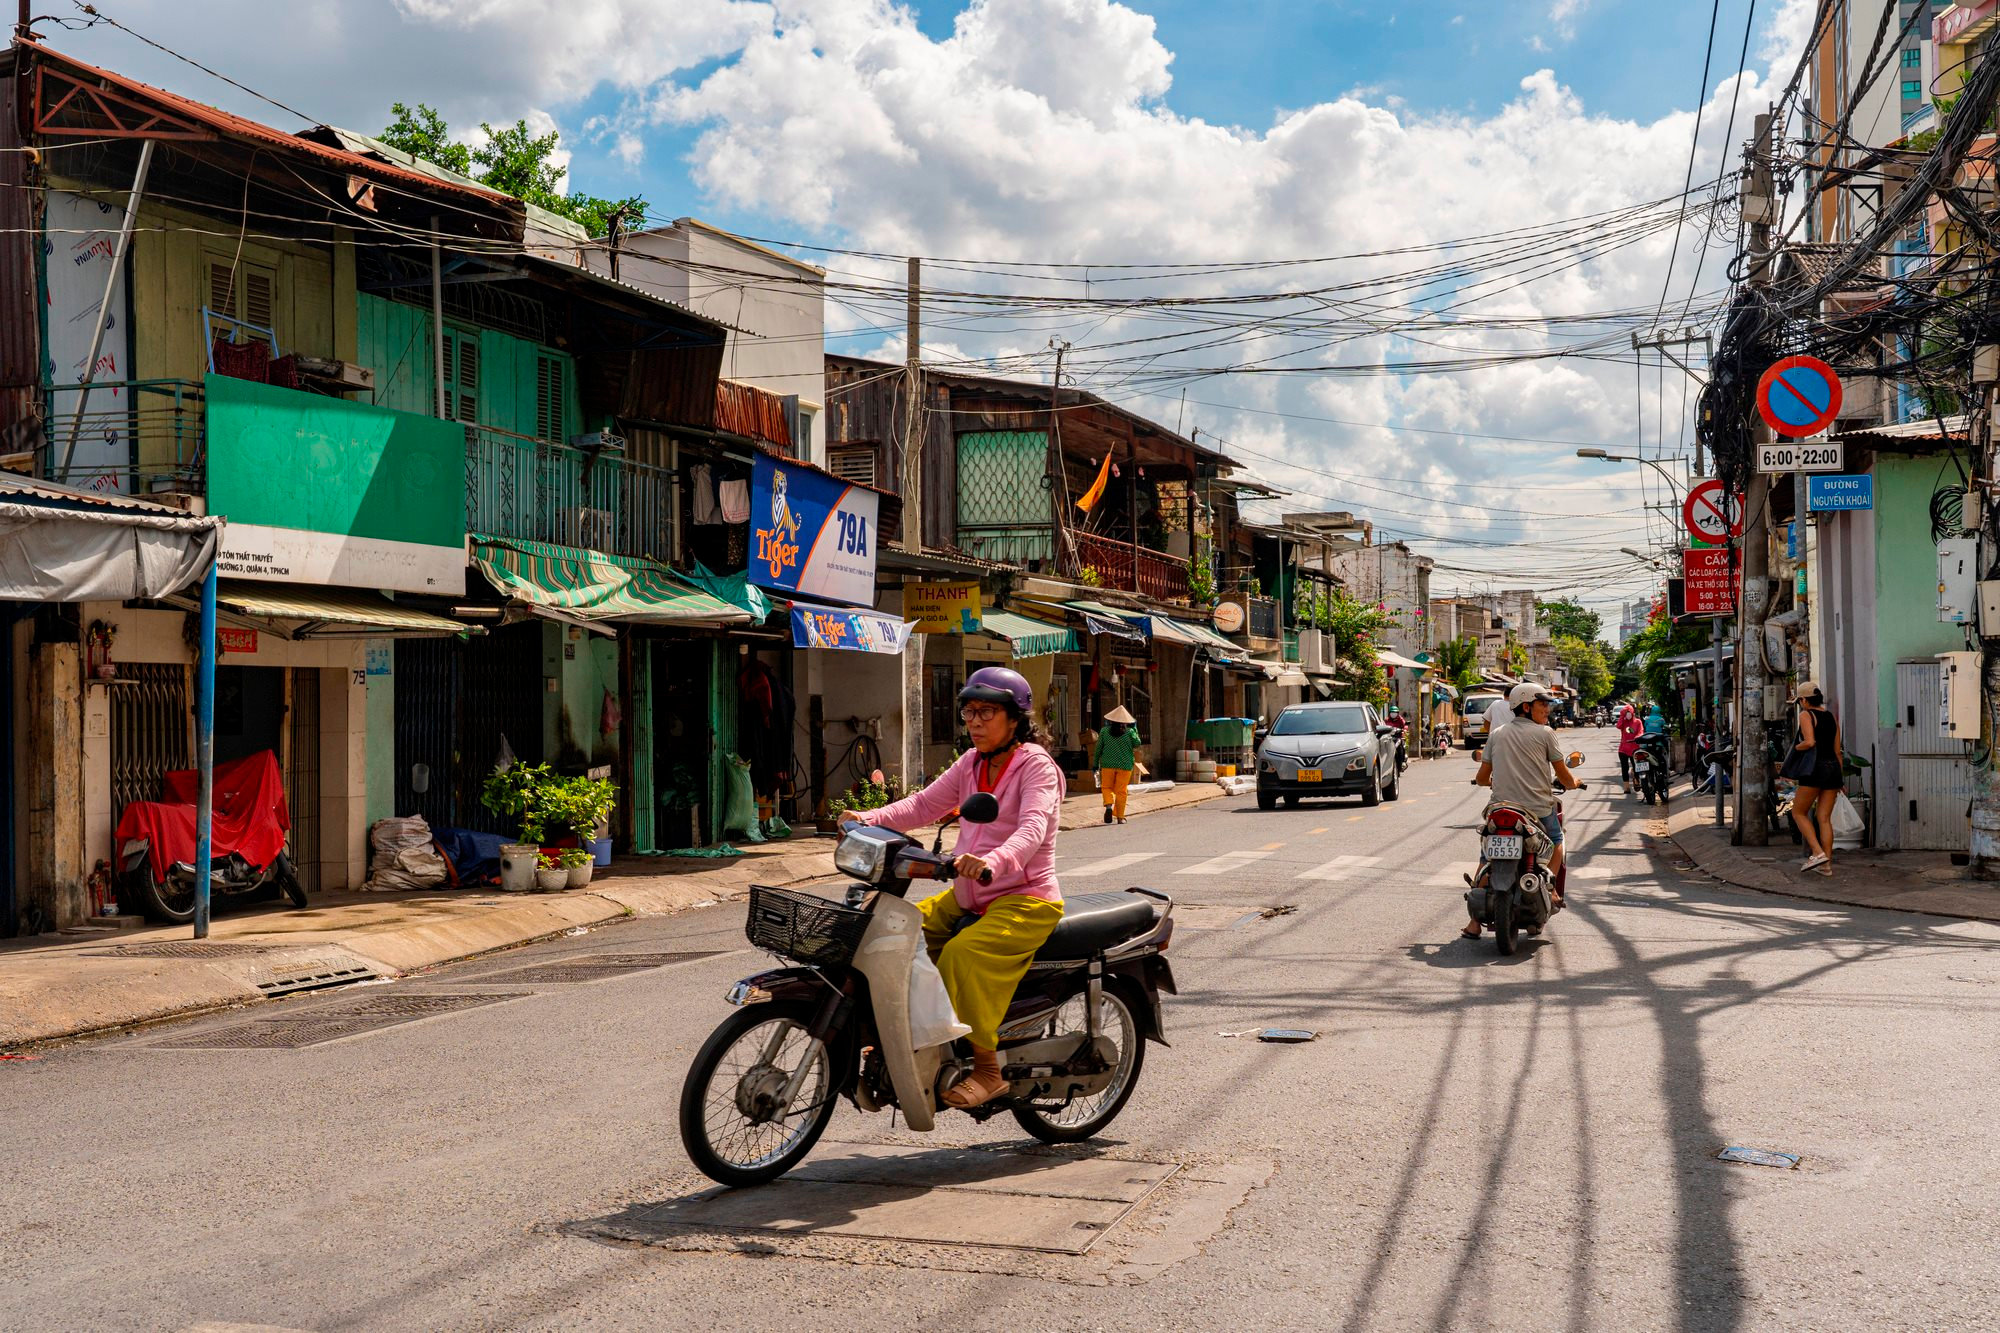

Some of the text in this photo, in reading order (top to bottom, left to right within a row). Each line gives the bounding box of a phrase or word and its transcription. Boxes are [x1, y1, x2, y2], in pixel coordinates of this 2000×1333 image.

[1823, 479, 1859, 490] ĐƯỜNG
[837, 509, 867, 558] 79A
[755, 528, 800, 579] Tiger
[270, 567, 290, 576] TPHCM
[815, 613, 847, 646] Tiger
[877, 620, 898, 644] 79A
[352, 670, 365, 685] 79
[1491, 837, 1516, 847] 59-Z1
[1487, 847, 1520, 858] 065.52
